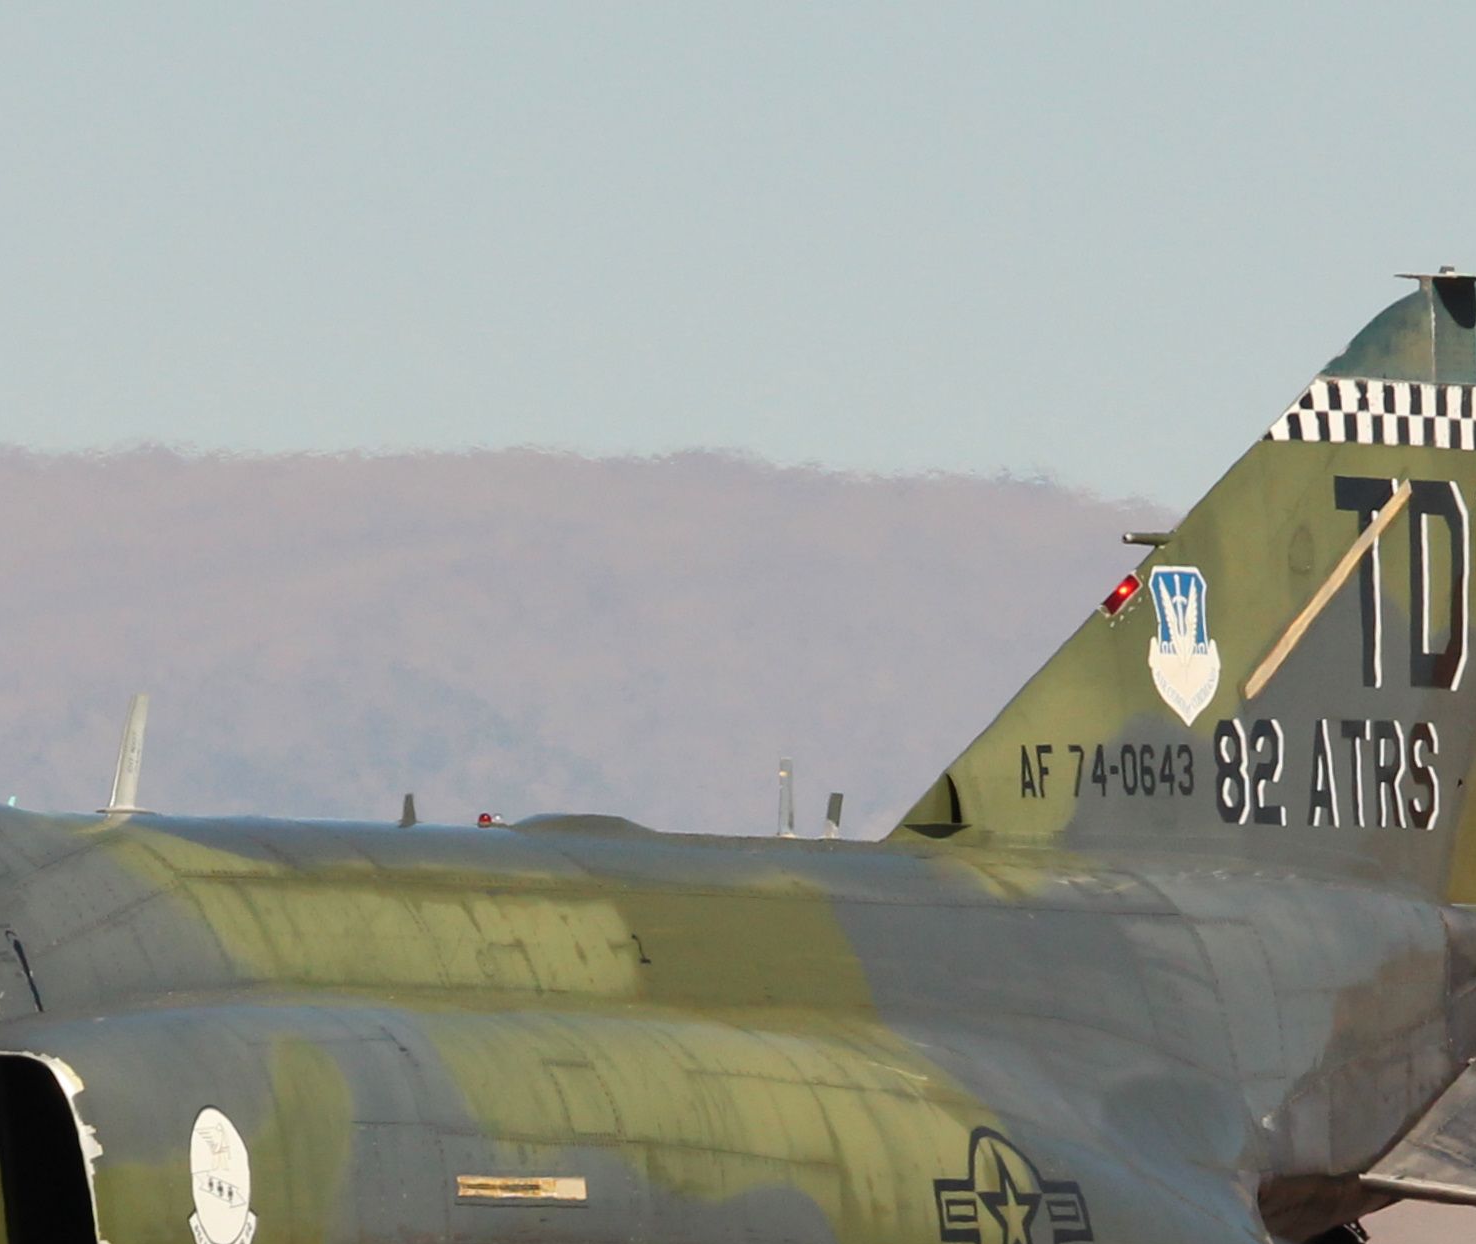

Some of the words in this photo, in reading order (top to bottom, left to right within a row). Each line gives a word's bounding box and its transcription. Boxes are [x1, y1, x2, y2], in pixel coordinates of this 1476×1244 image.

[1334, 475, 1468, 690] TD
[1021, 744, 1052, 798] AF
[1068, 744, 1194, 797] 74-0643
[1214, 718, 1286, 825] 82
[1308, 718, 1440, 831] ATRS
